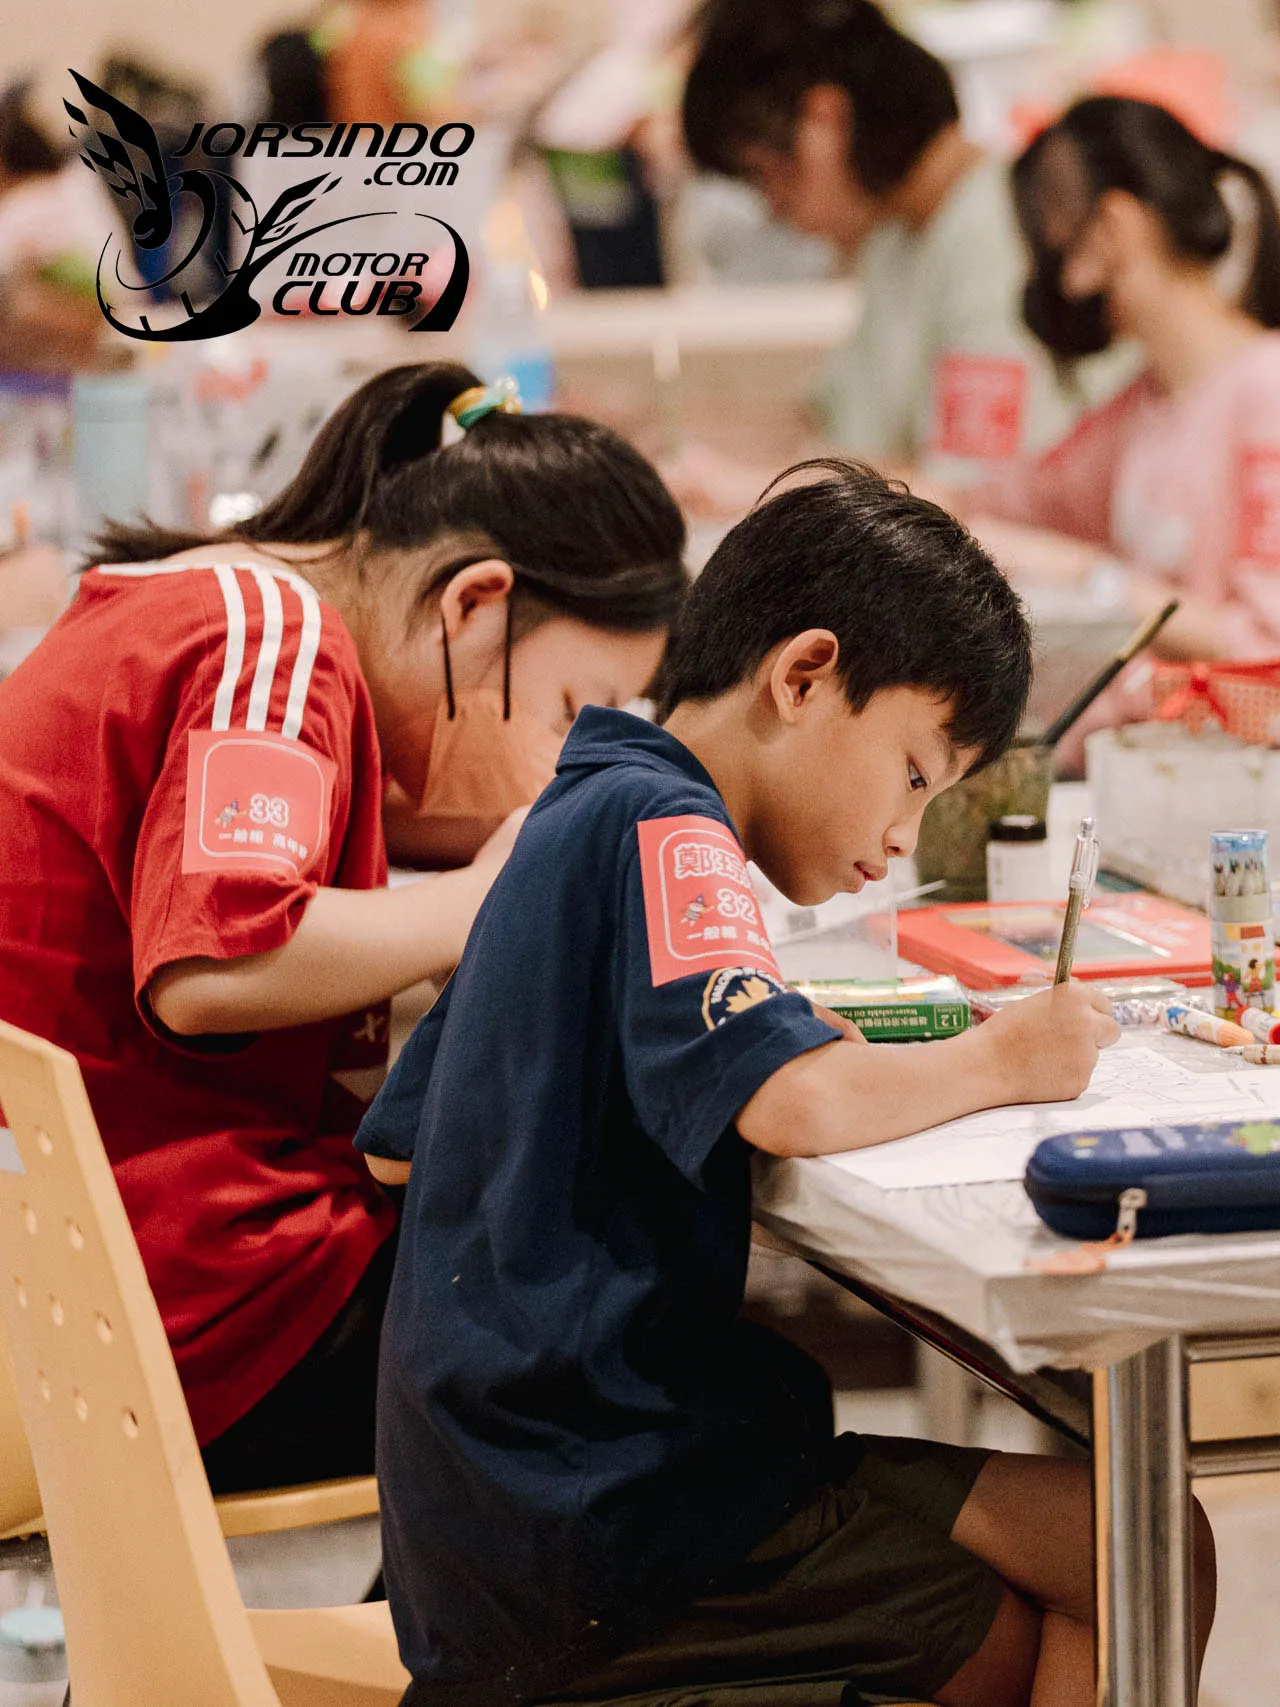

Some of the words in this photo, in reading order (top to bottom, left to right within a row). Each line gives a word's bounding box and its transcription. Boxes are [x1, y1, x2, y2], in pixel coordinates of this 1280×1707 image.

[250, 793, 290, 828] 33
[716, 888, 758, 925] 32
[941, 1014, 958, 1027] 12
